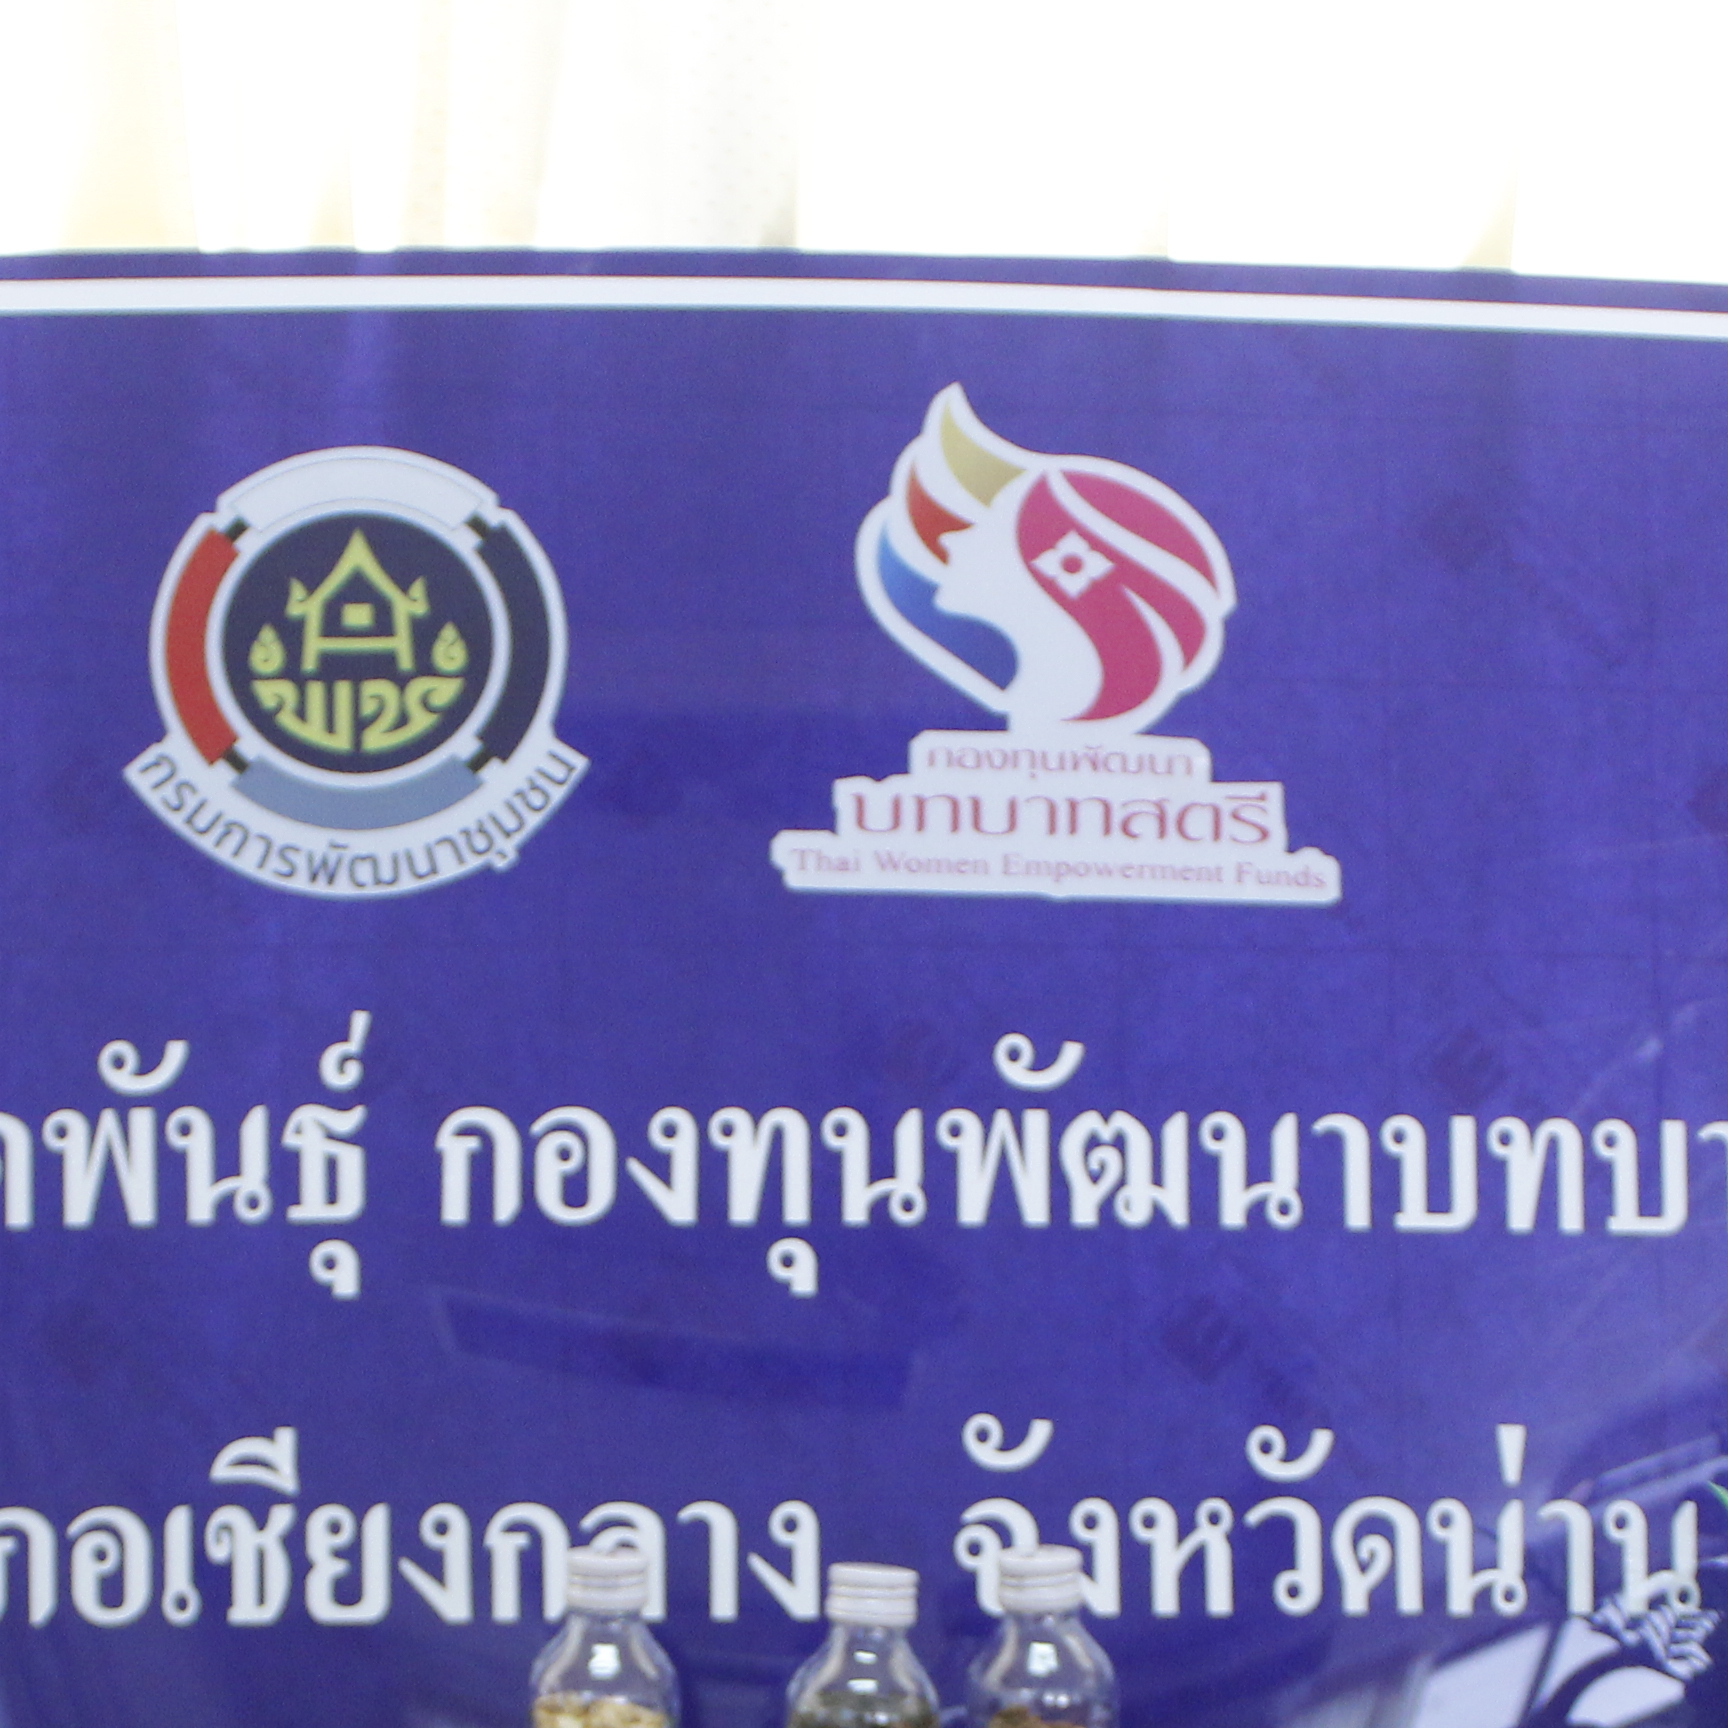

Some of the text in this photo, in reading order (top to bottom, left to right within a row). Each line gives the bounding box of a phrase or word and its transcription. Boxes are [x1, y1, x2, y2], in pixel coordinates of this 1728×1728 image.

[927, 744, 1193, 779] กองทุนพัฒนา
[138, 749, 576, 888] กรมการพัฒนาชุมชน
[851, 793, 1270, 844] บทบาทสตรี
[792, 848, 1328, 888] Thai Women Empowerment Funds
[954, 1412, 1702, 1618] จังหวัดน่าน
